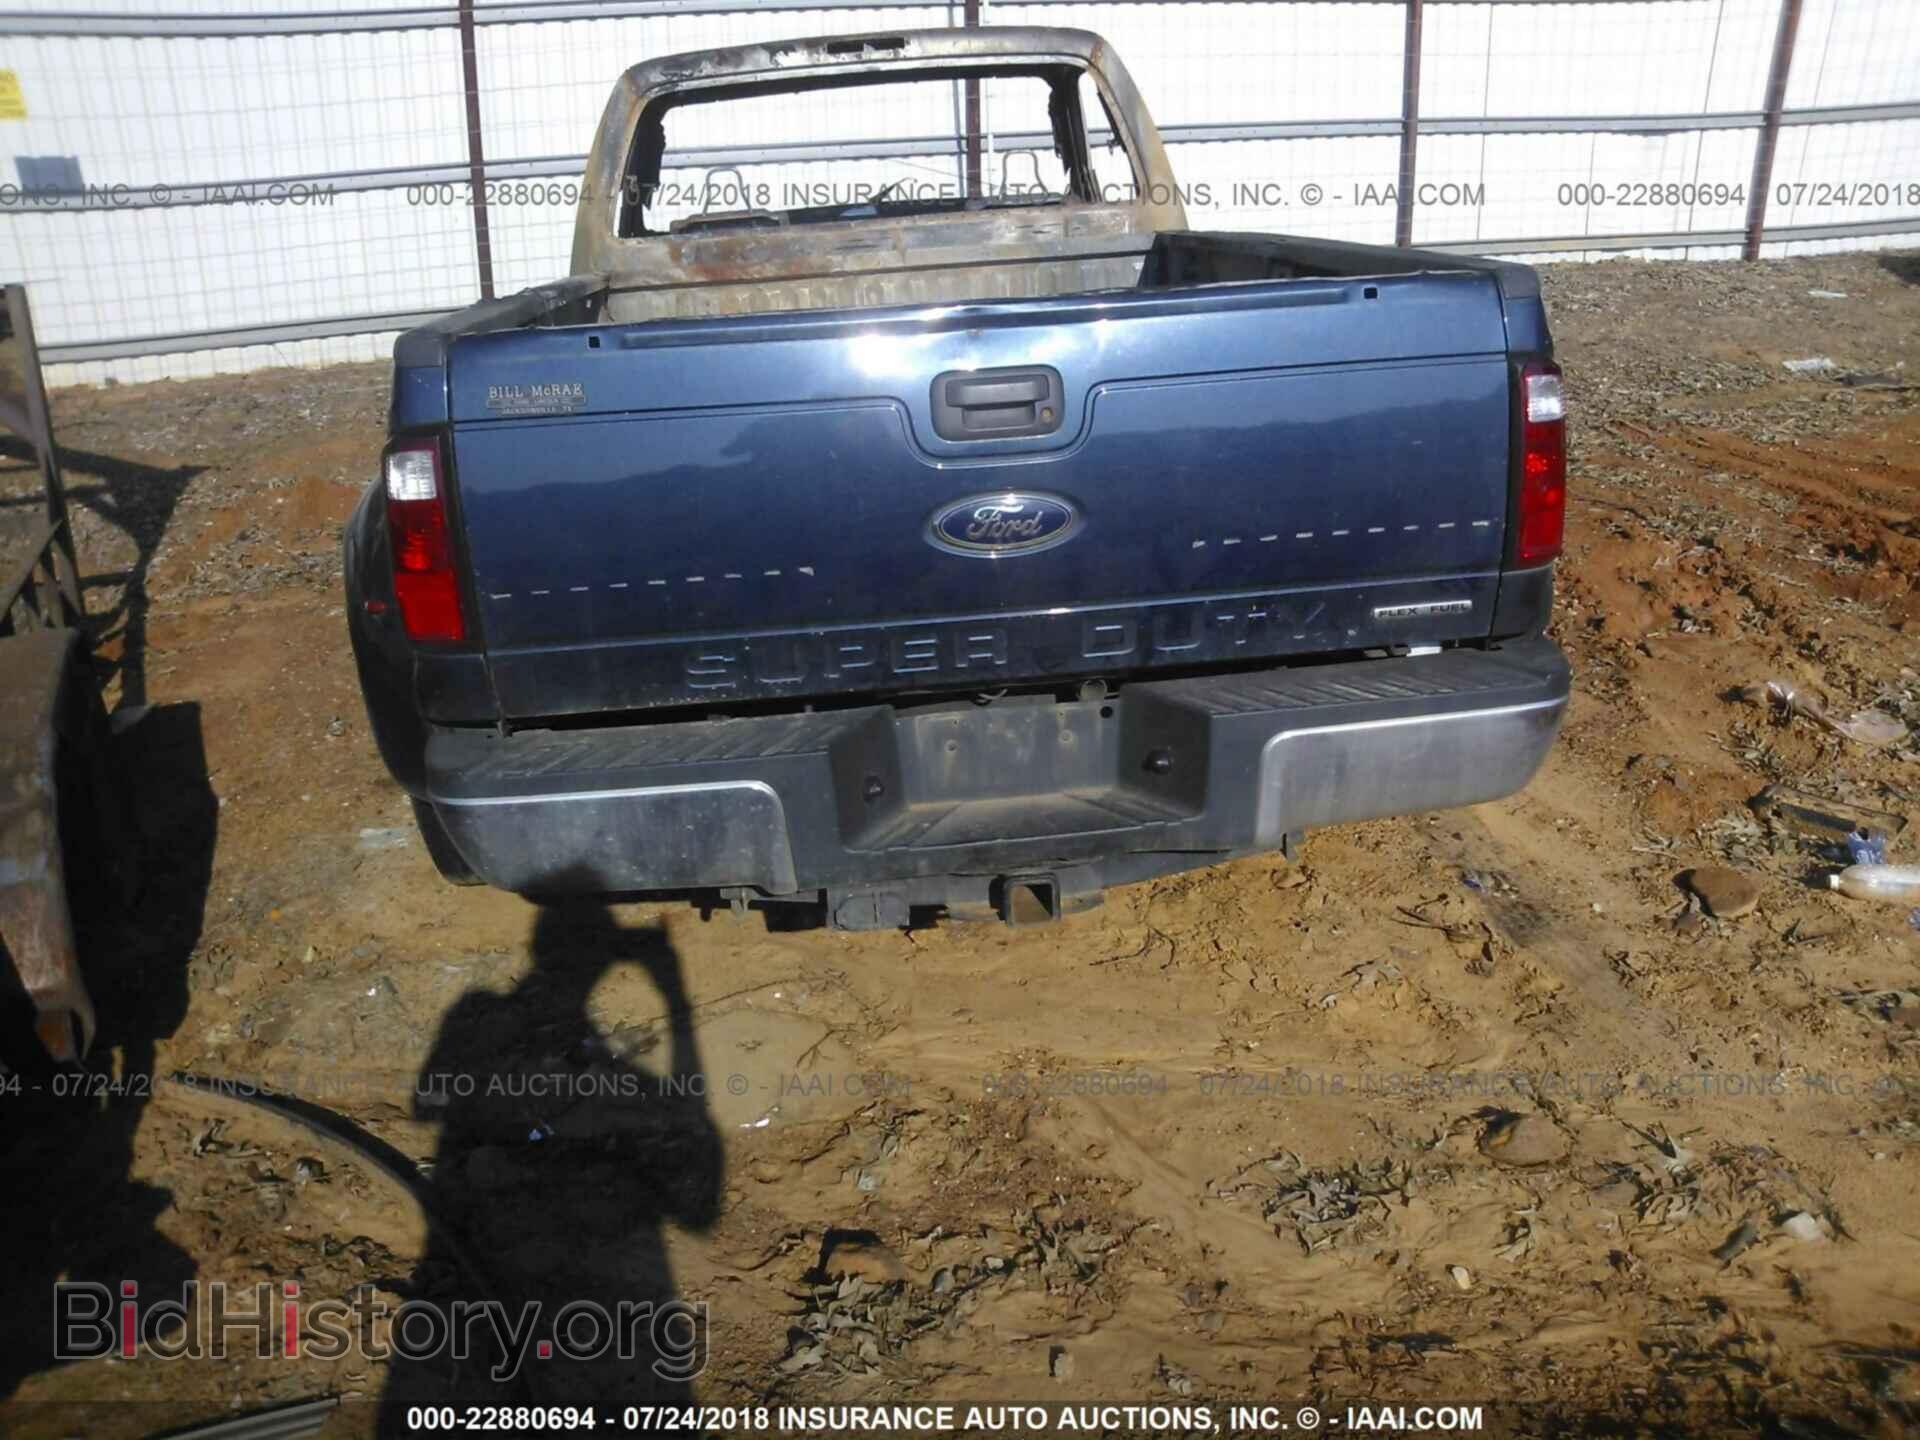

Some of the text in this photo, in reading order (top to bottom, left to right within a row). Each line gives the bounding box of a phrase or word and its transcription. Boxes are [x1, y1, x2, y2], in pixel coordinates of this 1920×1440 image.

[488, 382, 584, 399] BILL McRAE
[966, 504, 1043, 540] Ford
[1378, 607, 1418, 618] FLEX
[686, 631, 1008, 689] SUPER
